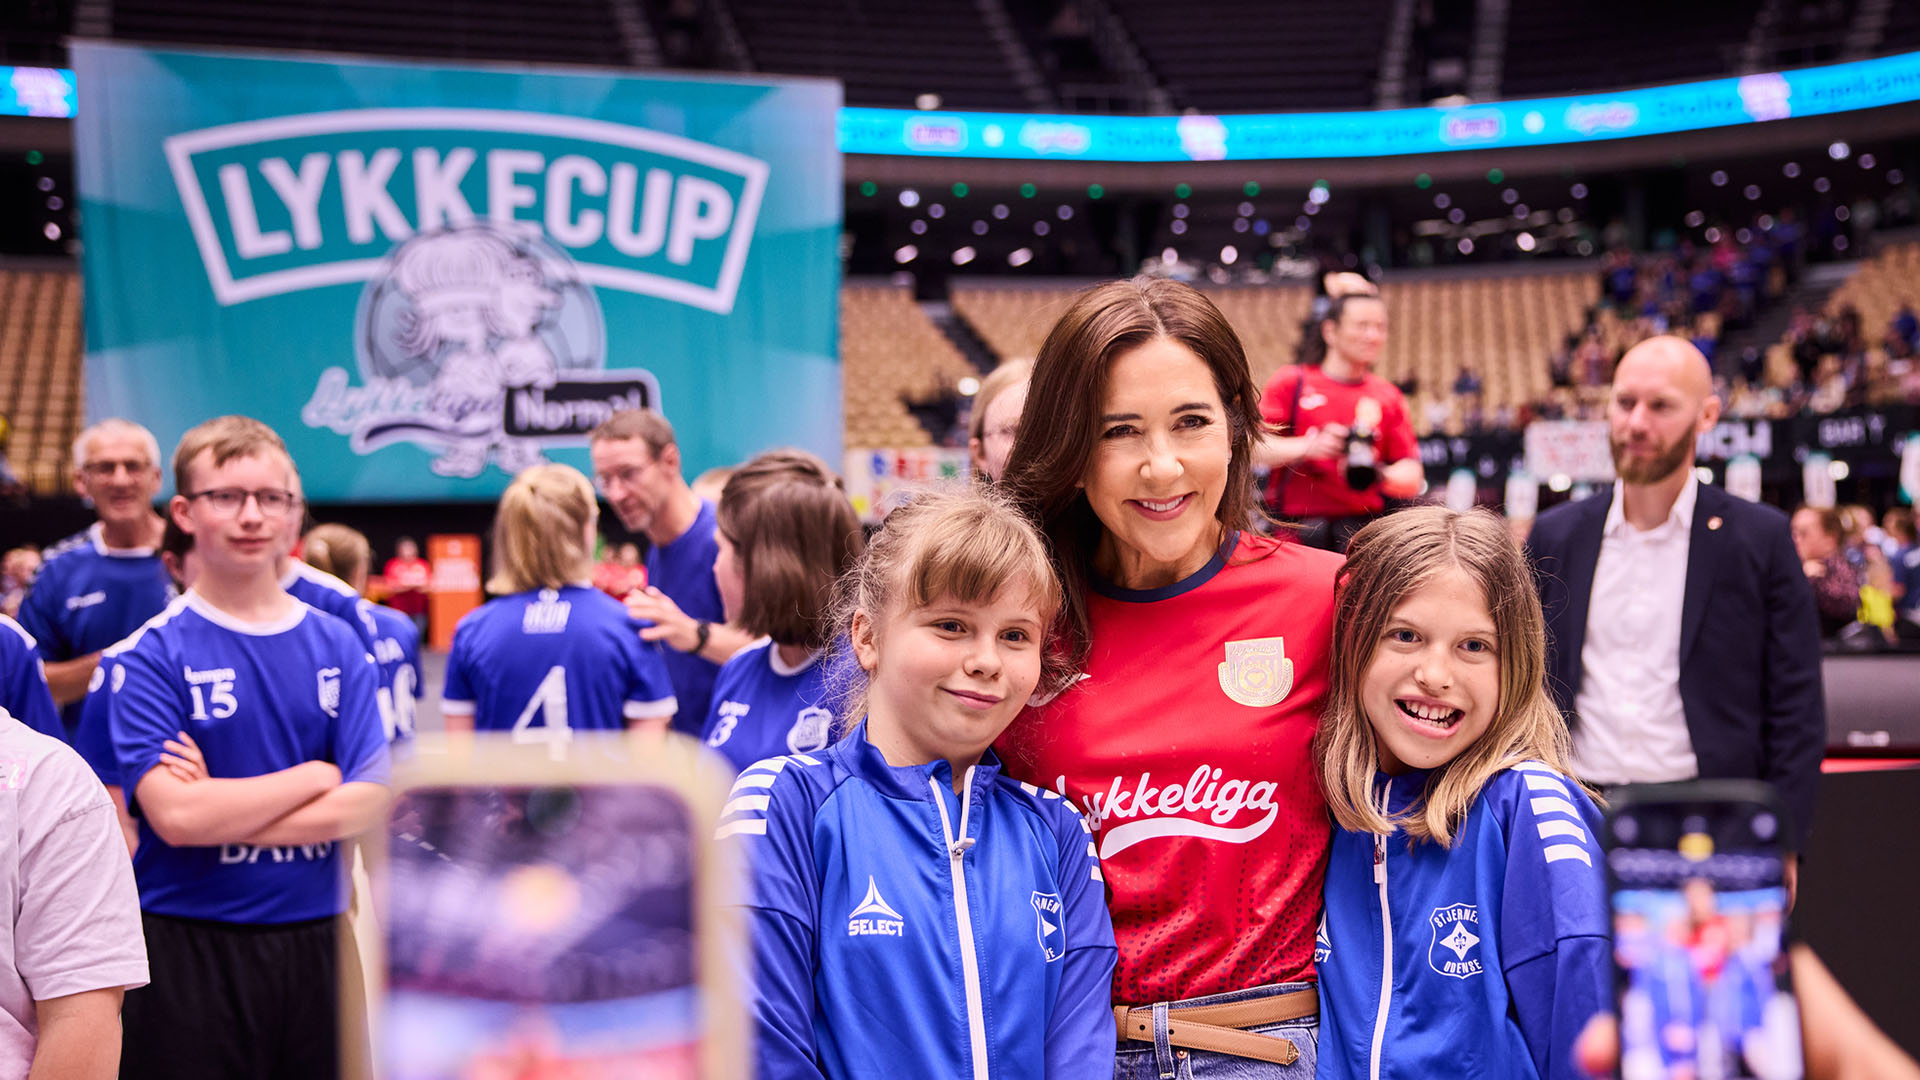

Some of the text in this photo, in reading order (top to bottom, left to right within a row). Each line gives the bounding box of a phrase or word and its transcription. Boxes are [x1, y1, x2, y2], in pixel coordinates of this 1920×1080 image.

[218, 147, 735, 266] LYKKECUP
[189, 681, 238, 720] 15
[511, 665, 574, 761] 4
[1056, 764, 1278, 831] ykkeliga
[848, 919, 904, 936] SELECT
[1443, 959, 1482, 974] ODENSE
